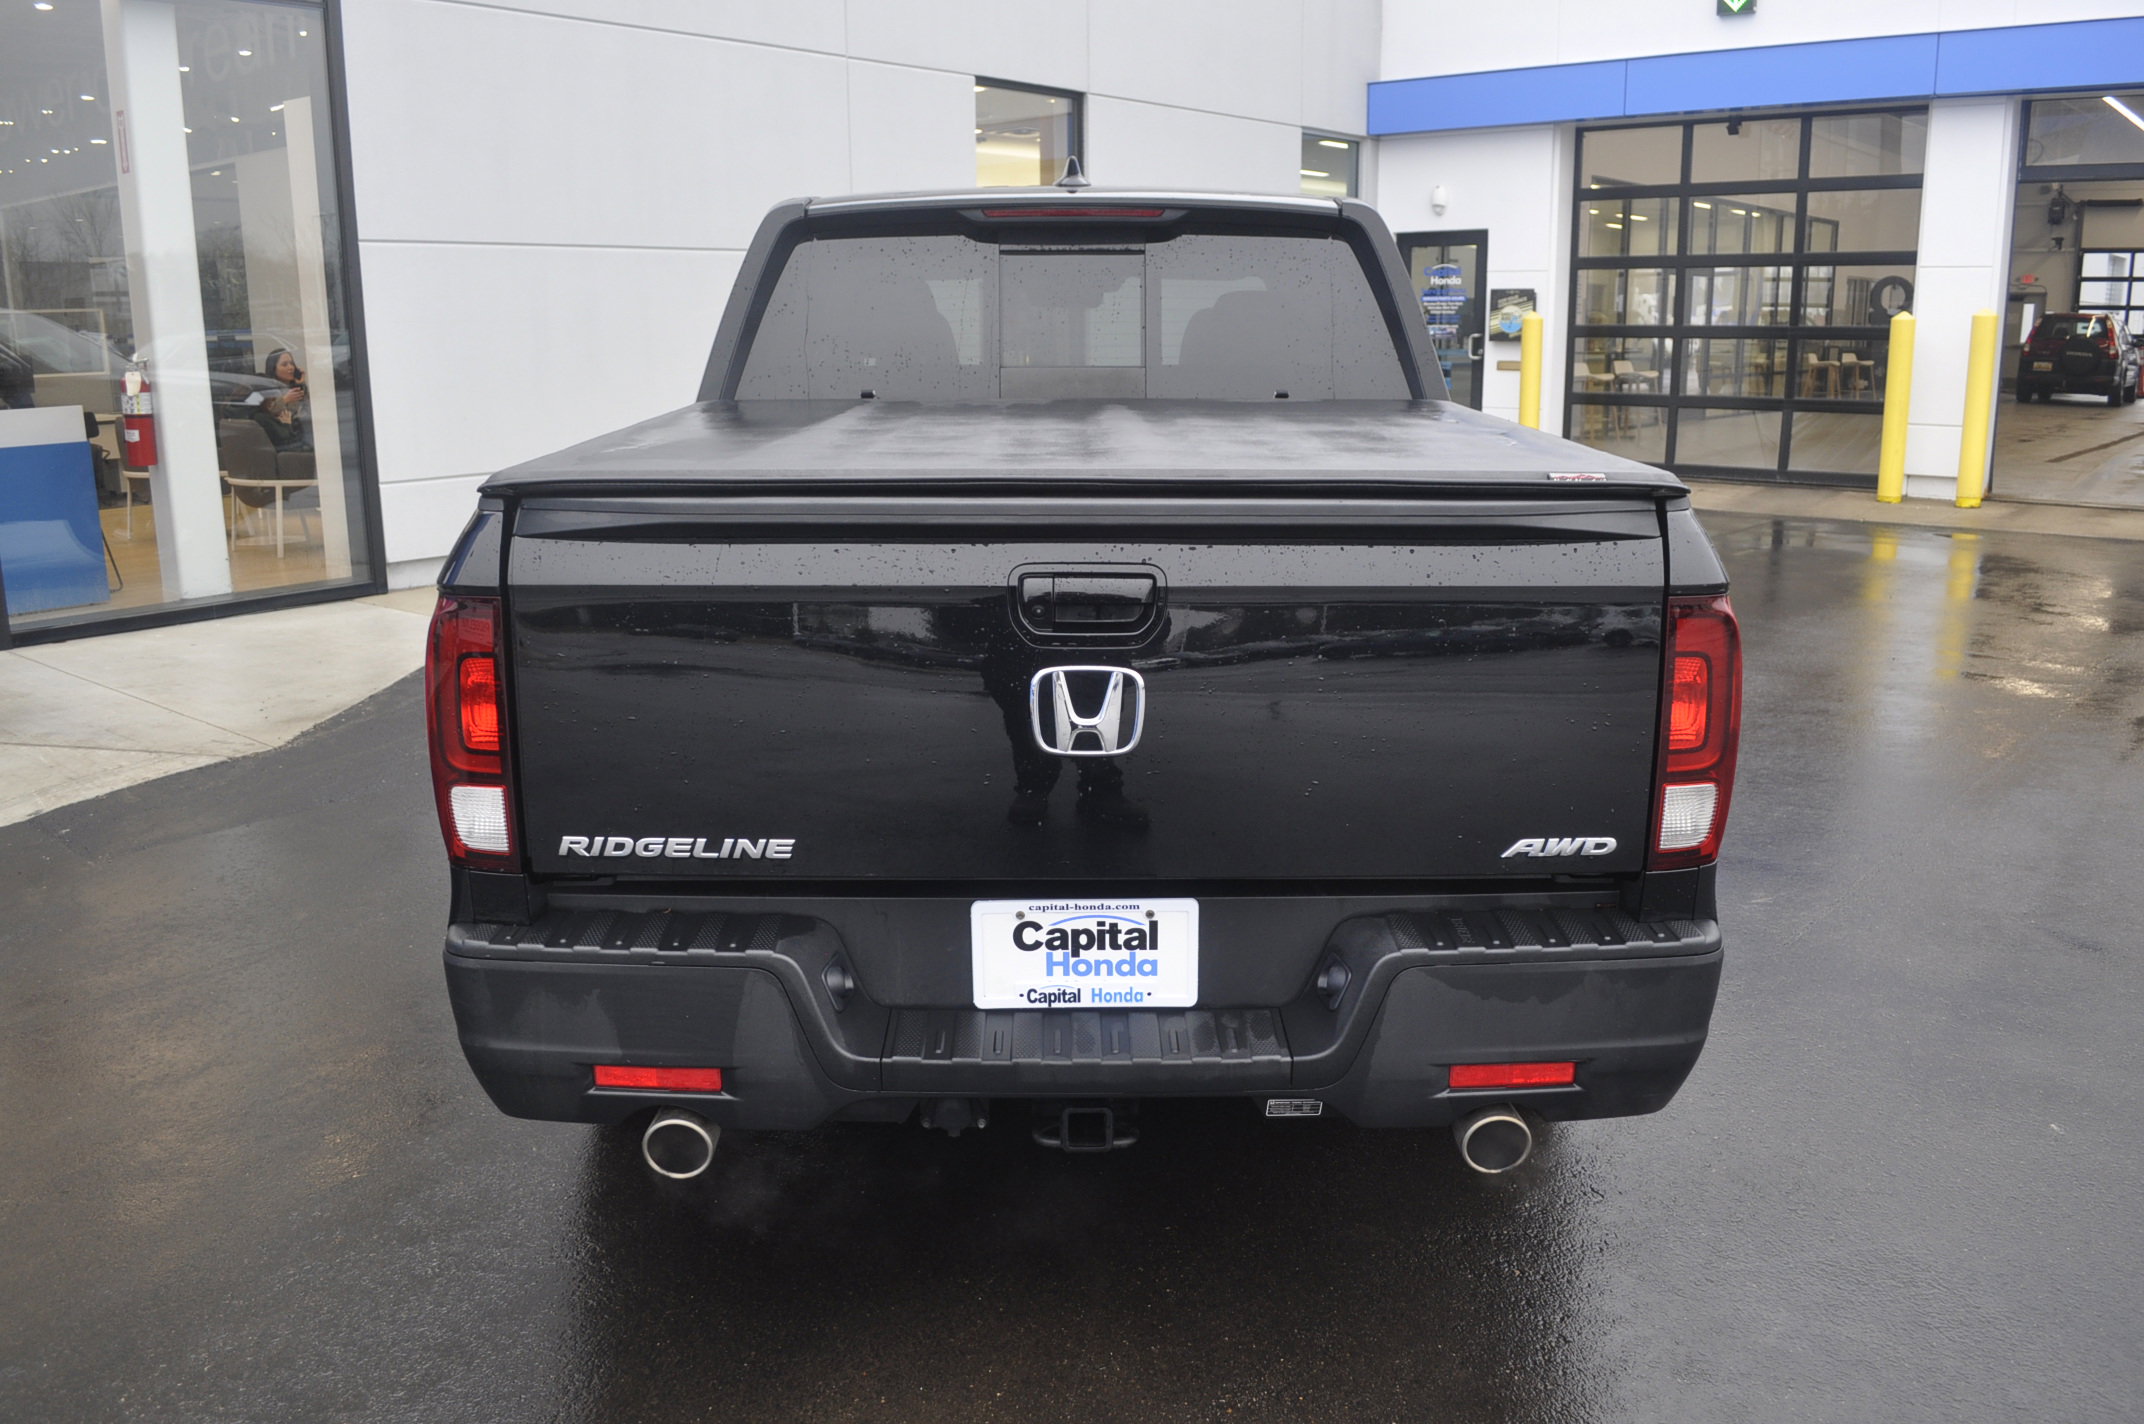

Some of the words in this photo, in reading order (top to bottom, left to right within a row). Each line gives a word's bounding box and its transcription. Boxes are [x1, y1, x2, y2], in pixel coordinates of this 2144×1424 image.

[1430, 275, 1462, 285] Honda
[558, 836, 796, 859] RIDGELINE
[1500, 837, 1617, 858] AWD
[1028, 903, 1140, 912] capital-honda.com
[1012, 920, 1158, 958] Capital
[1046, 951, 1158, 976] Honda
[1026, 988, 1081, 1007] Capital
[1091, 986, 1144, 1003] Honda
